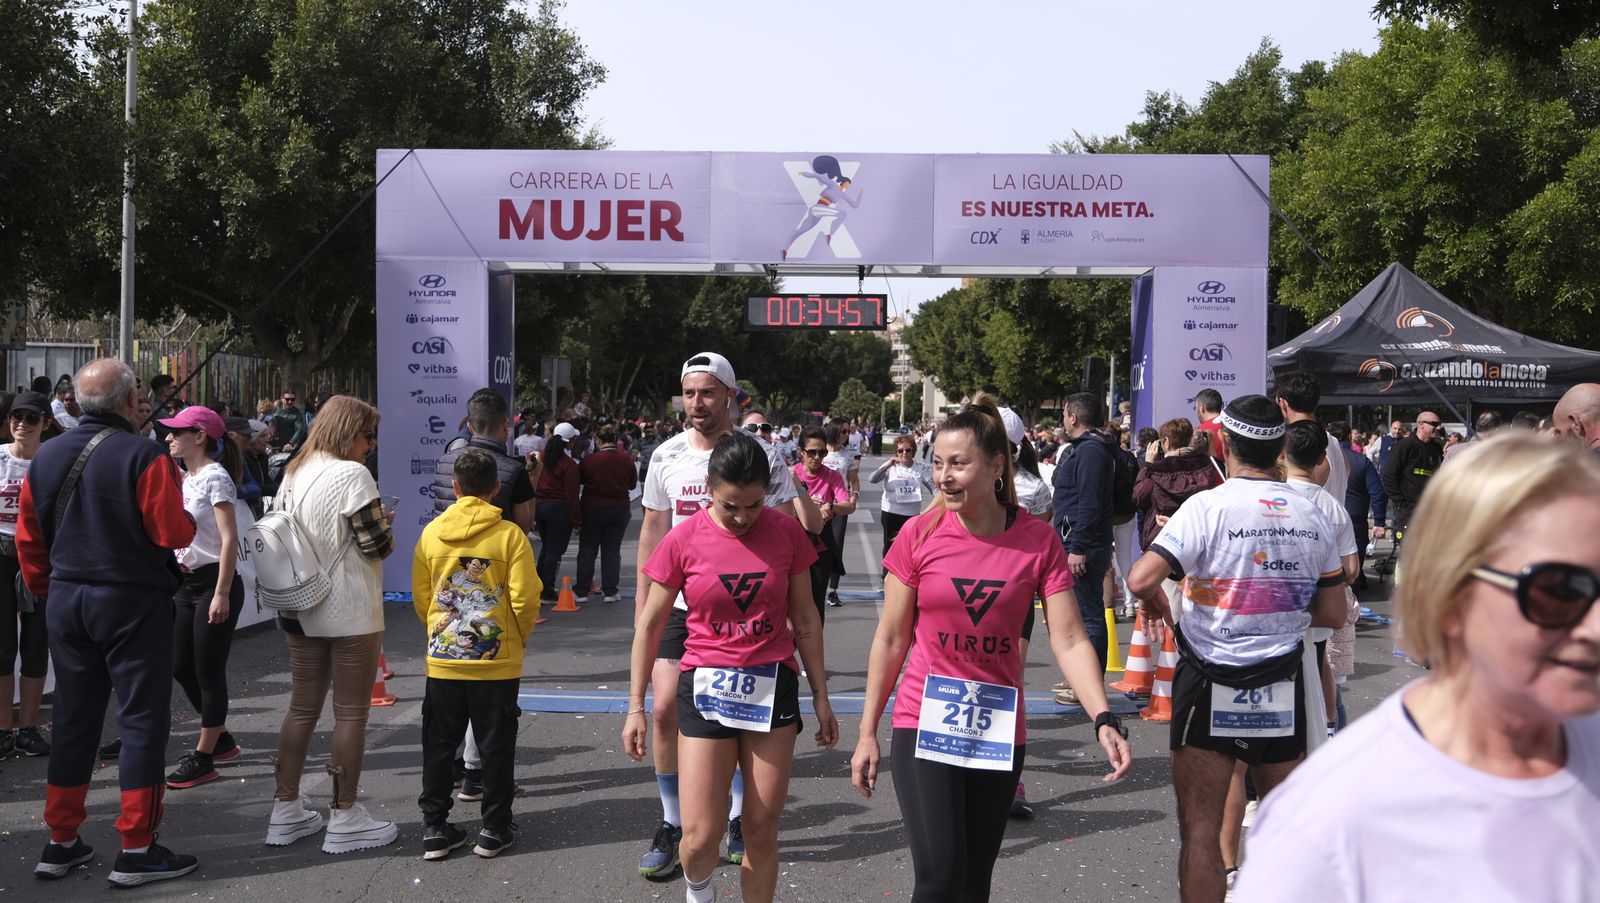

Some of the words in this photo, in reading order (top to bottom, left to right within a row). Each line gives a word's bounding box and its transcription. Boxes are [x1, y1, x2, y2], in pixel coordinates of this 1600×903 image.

[509, 171, 608, 190] CARRERA
[614, 172, 641, 190] DE
[648, 172, 674, 190] LA
[992, 173, 1017, 190] LA
[1022, 173, 1124, 191] IGUALDAD
[961, 200, 987, 218] ES
[991, 200, 1089, 218] NUESTRA
[1092, 201, 1155, 218] META.
[498, 198, 685, 242] MUJER
[1037, 229, 1074, 238] ALMERÍA
[1186, 296, 1236, 304] HYUNDAI
[767, 297, 881, 326] 00:34:57
[420, 315, 460, 324] cajamar
[1198, 321, 1239, 331] cajamar
[423, 363, 458, 374] vithas
[1200, 371, 1236, 381] vithas
[1445, 378, 1503, 388] cronometraje
[1504, 379, 1546, 389] deportivo
[417, 394, 457, 406] aqualia
[420, 436, 447, 446] Clece
[899, 486, 917, 494] 1324
[1262, 559, 1300, 571] sdtec
[711, 619, 774, 637] VIRUS
[938, 631, 1012, 654] VIRUS
[711, 670, 757, 695] 218
[716, 690, 742, 700] CHACON
[1231, 687, 1274, 705] 261
[942, 703, 993, 731] 215
[949, 726, 978, 735] CHACON
